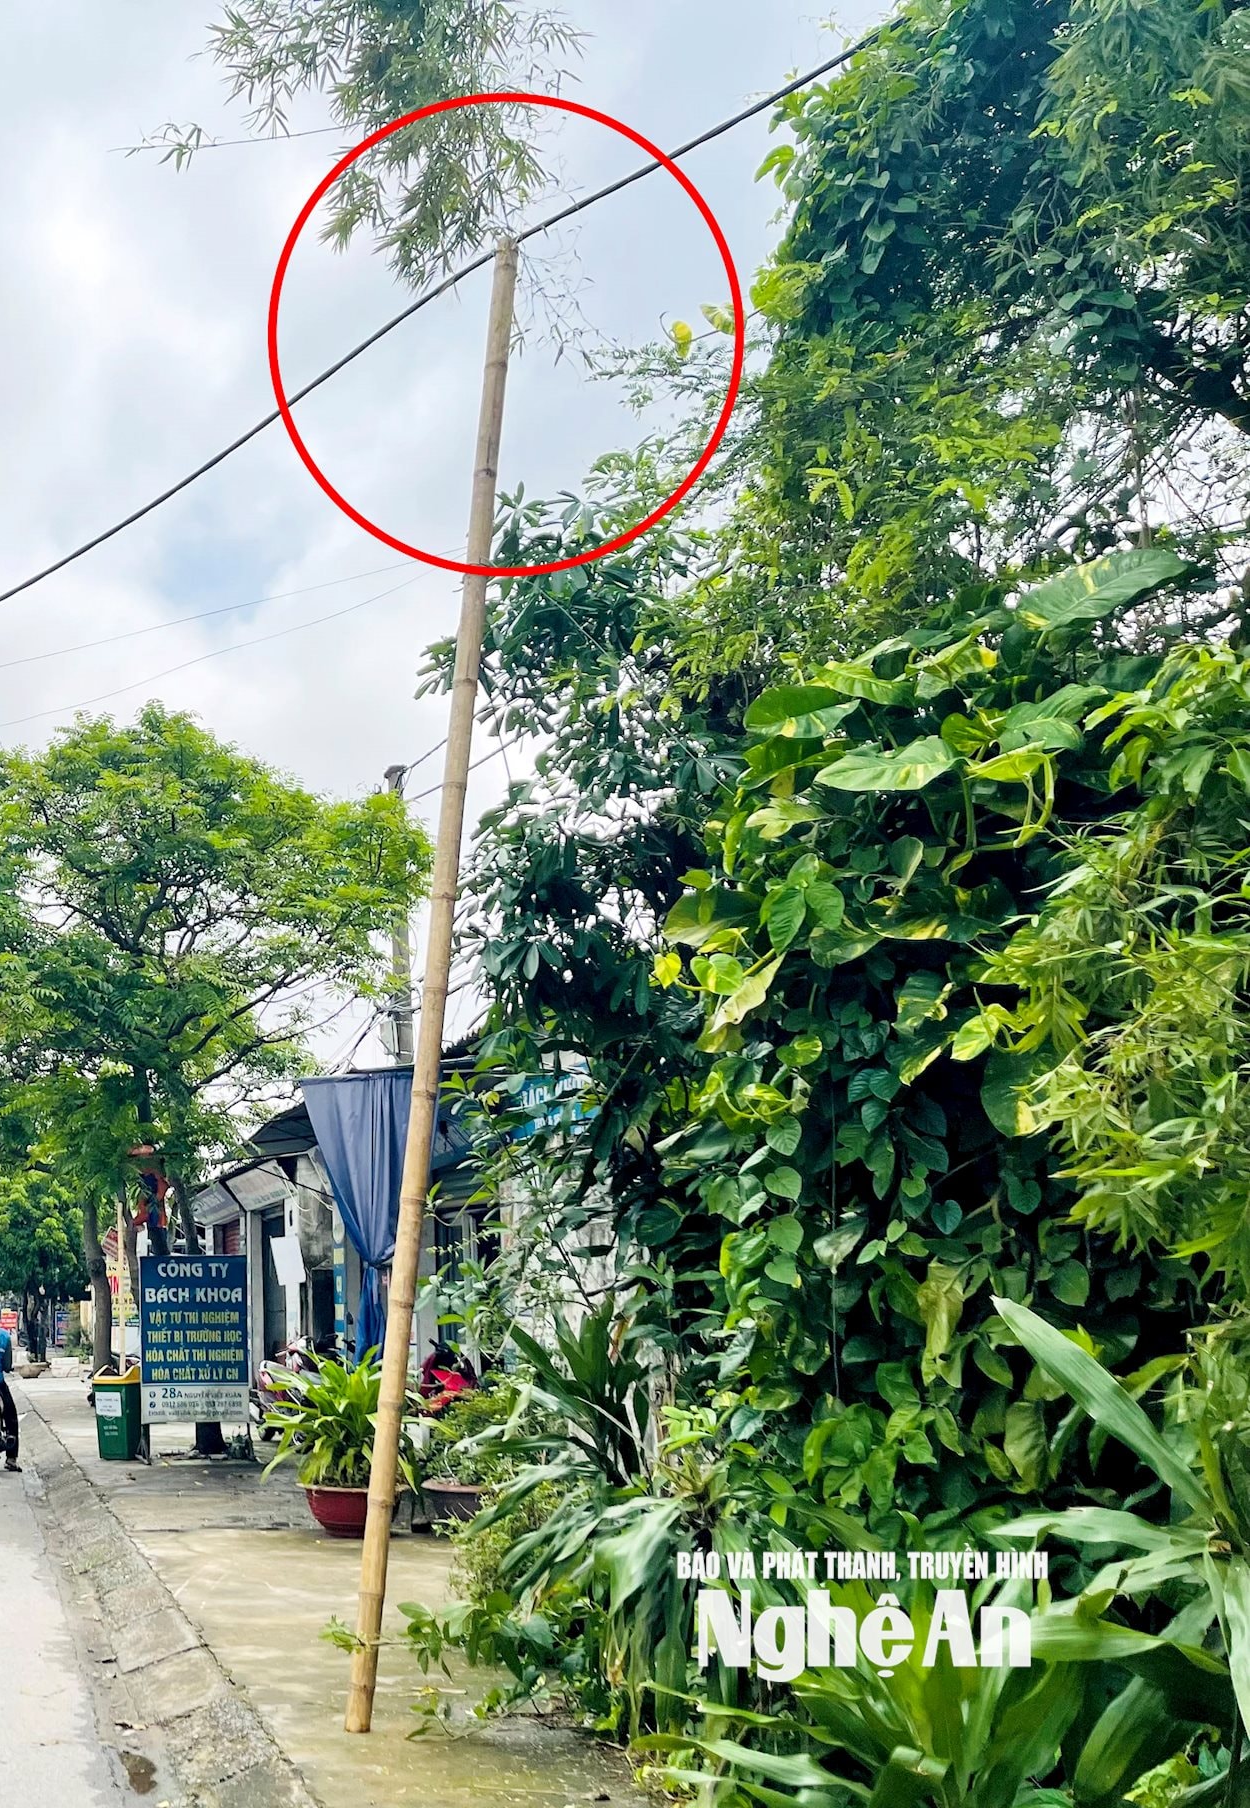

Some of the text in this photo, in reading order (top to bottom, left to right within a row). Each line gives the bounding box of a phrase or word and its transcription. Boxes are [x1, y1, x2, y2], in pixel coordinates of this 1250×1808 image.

[157, 1259, 229, 1278] CÔNG TY
[145, 1284, 243, 1304] BÁCH KHOA
[149, 1309, 167, 1327] VẬT
[170, 1310, 182, 1324] TƯ
[202, 1309, 239, 1326] NGHIỆM
[147, 1326, 242, 1345] THIẾT BỊ TRƯỜNG HỌC
[145, 1347, 164, 1362] HÓA
[166, 1345, 190, 1362] CHẤT
[208, 1346, 244, 1364] NGHIỆM
[151, 1366, 170, 1381] HÓA
[172, 1364, 196, 1381] CHẤT
[161, 1387, 183, 1399] 28A
